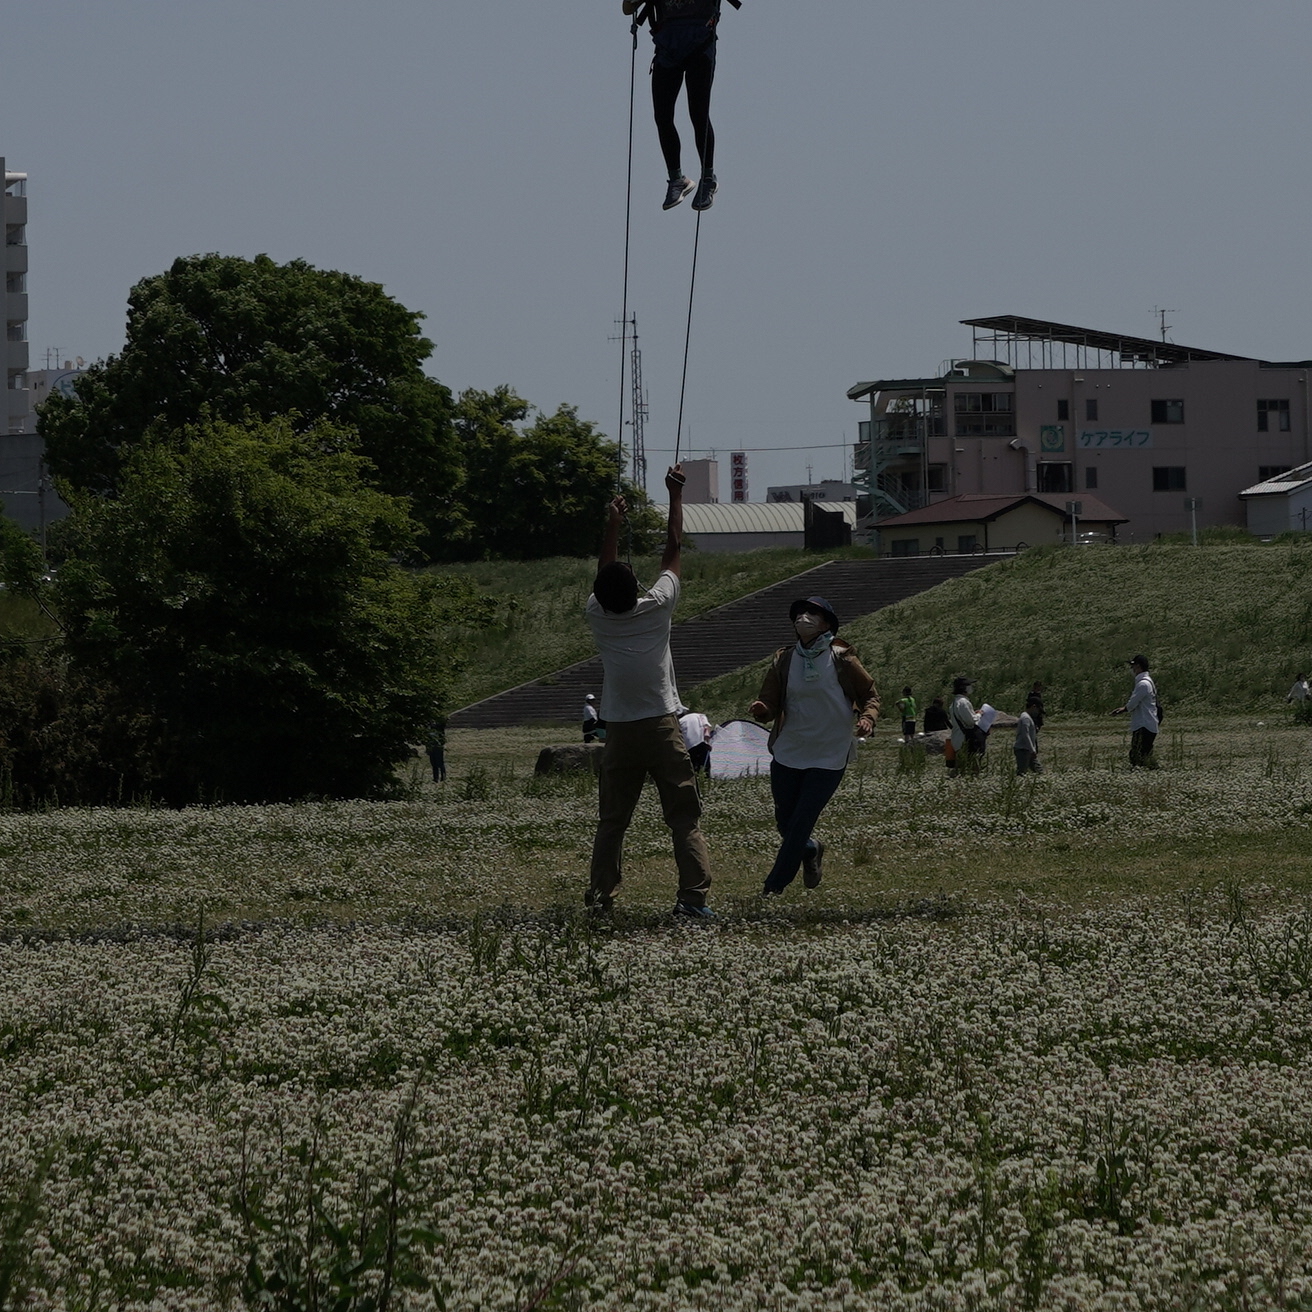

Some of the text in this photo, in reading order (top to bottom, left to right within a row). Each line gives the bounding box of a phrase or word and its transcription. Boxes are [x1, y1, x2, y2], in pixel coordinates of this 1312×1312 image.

[1081, 430, 1150, 447] ケアライフ
